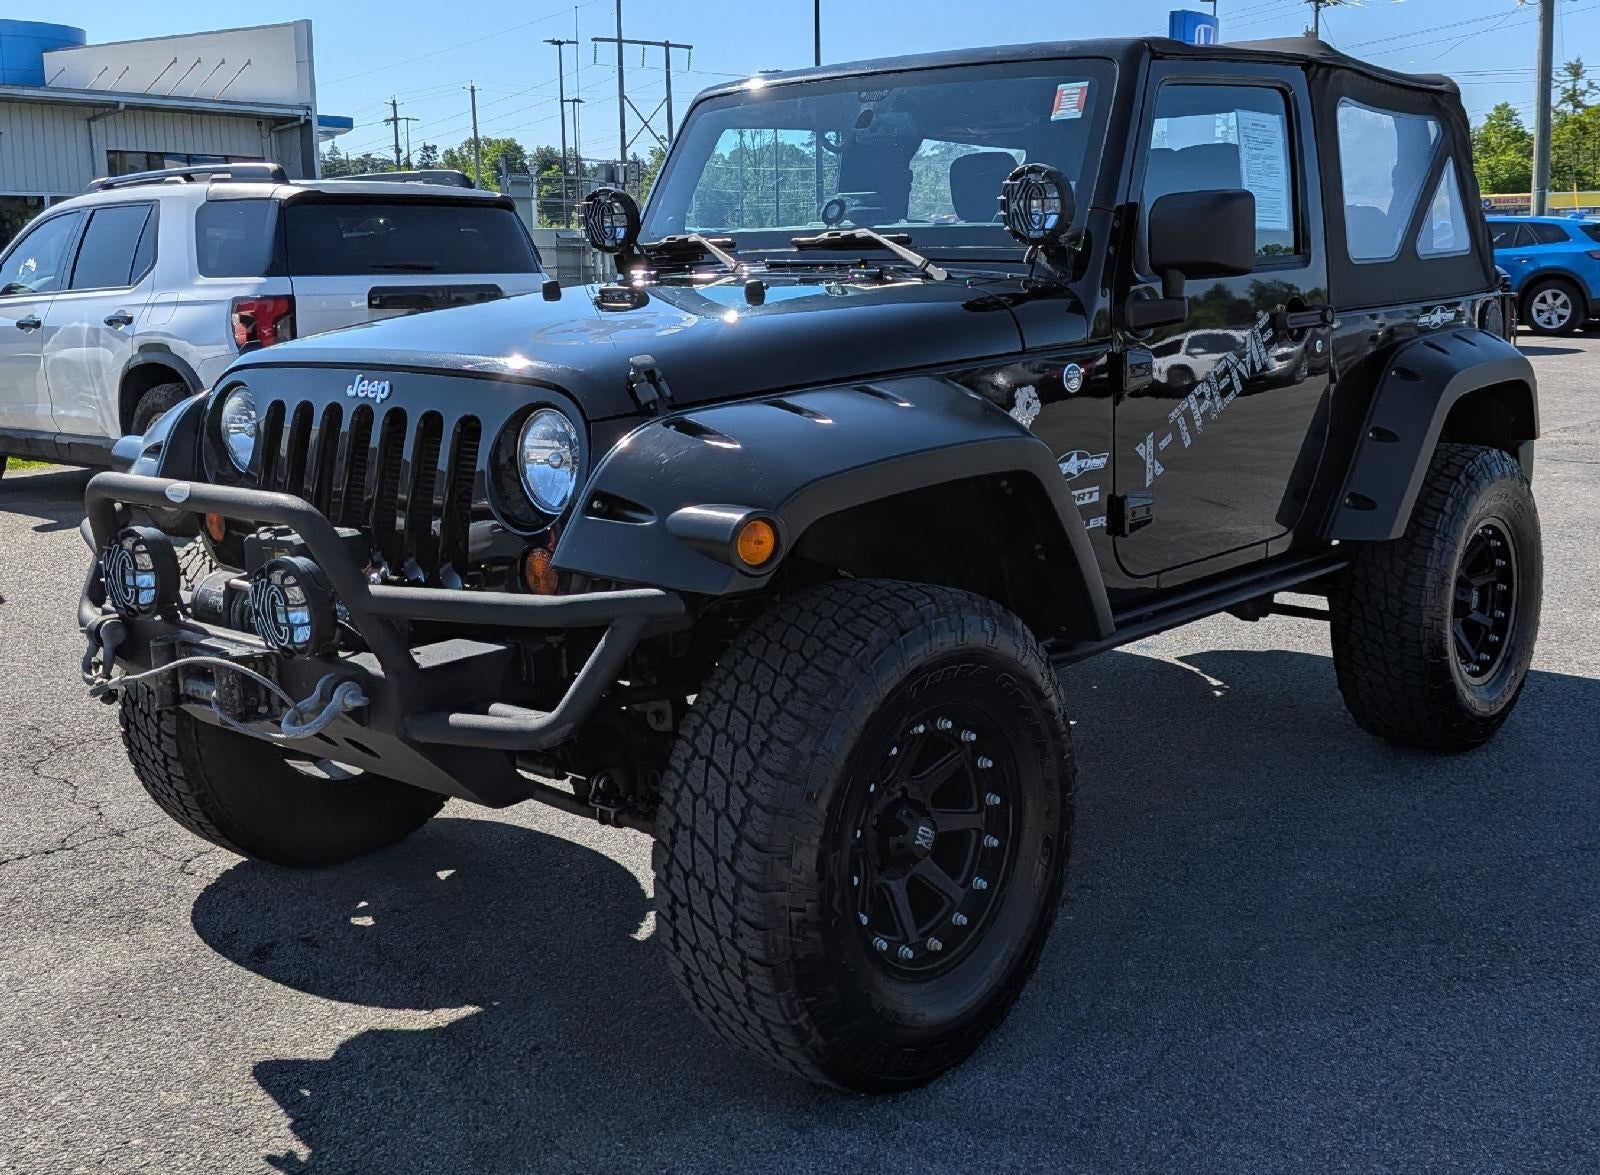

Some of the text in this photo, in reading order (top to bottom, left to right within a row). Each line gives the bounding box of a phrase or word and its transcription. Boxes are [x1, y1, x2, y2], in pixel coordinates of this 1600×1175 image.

[1004, 178, 1046, 238] KC
[346, 374, 389, 403] Jeep
[1136, 310, 1278, 488] X-TREME
[103, 544, 135, 608] KC
[249, 579, 289, 650] KC
